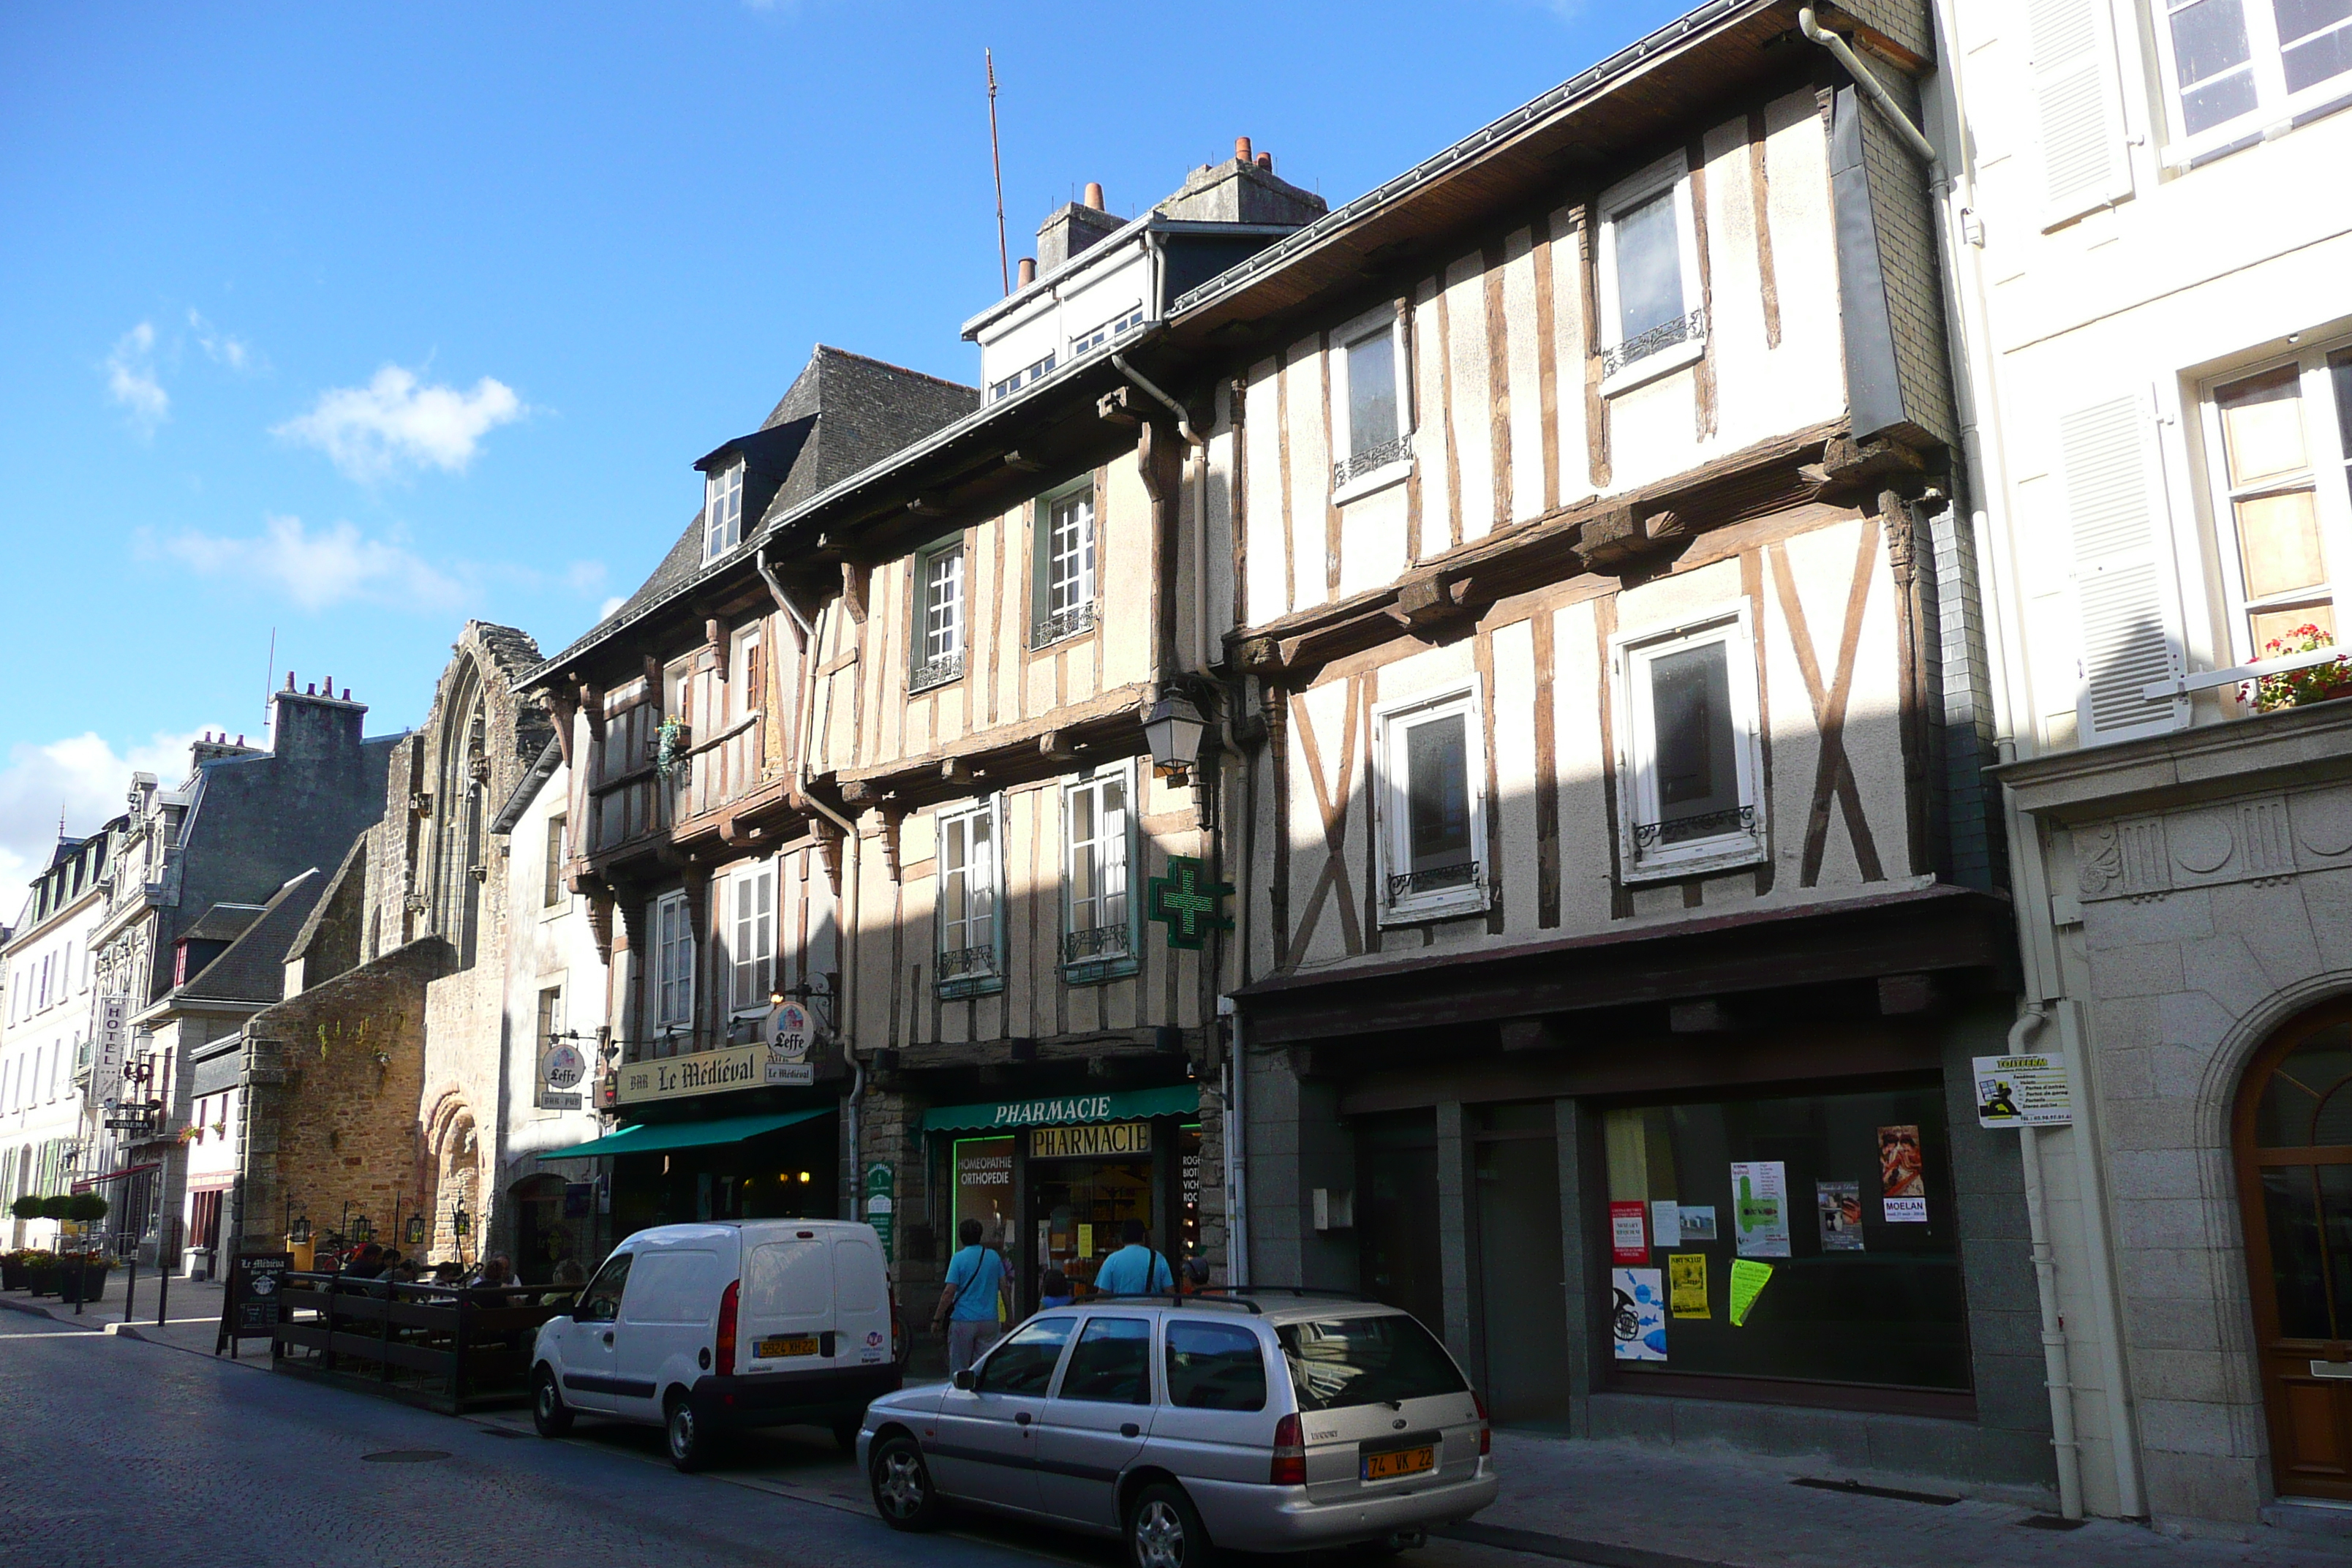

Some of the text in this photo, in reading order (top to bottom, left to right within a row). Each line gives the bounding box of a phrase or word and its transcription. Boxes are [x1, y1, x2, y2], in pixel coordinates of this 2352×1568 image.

[103, 1007, 121, 1065] HOTEL
[774, 1032, 805, 1050] Leffe
[549, 1068, 576, 1084] Leffe
[630, 1074, 649, 1090] BAR
[657, 1066, 677, 1091] Le
[682, 1053, 755, 1089] Médiéval
[768, 1068, 810, 1079] Le Médiéval
[544, 1097, 559, 1105] BAR
[565, 1097, 579, 1106] PUB
[995, 1096, 1111, 1123] PHARMACIE
[113, 1120, 149, 1128] CINEMA
[1033, 1124, 1149, 1156] PHARMACIE
[957, 1156, 1012, 1170] HOMEOPATHIE
[961, 1172, 1009, 1186] ORTHOPEDIE
[1886, 1202, 1923, 1210] MOELAN
[241, 1259, 251, 1268] Le
[762, 1341, 815, 1354] 5924 XH 22
[1371, 1448, 1433, 1475] 74 VK 22
